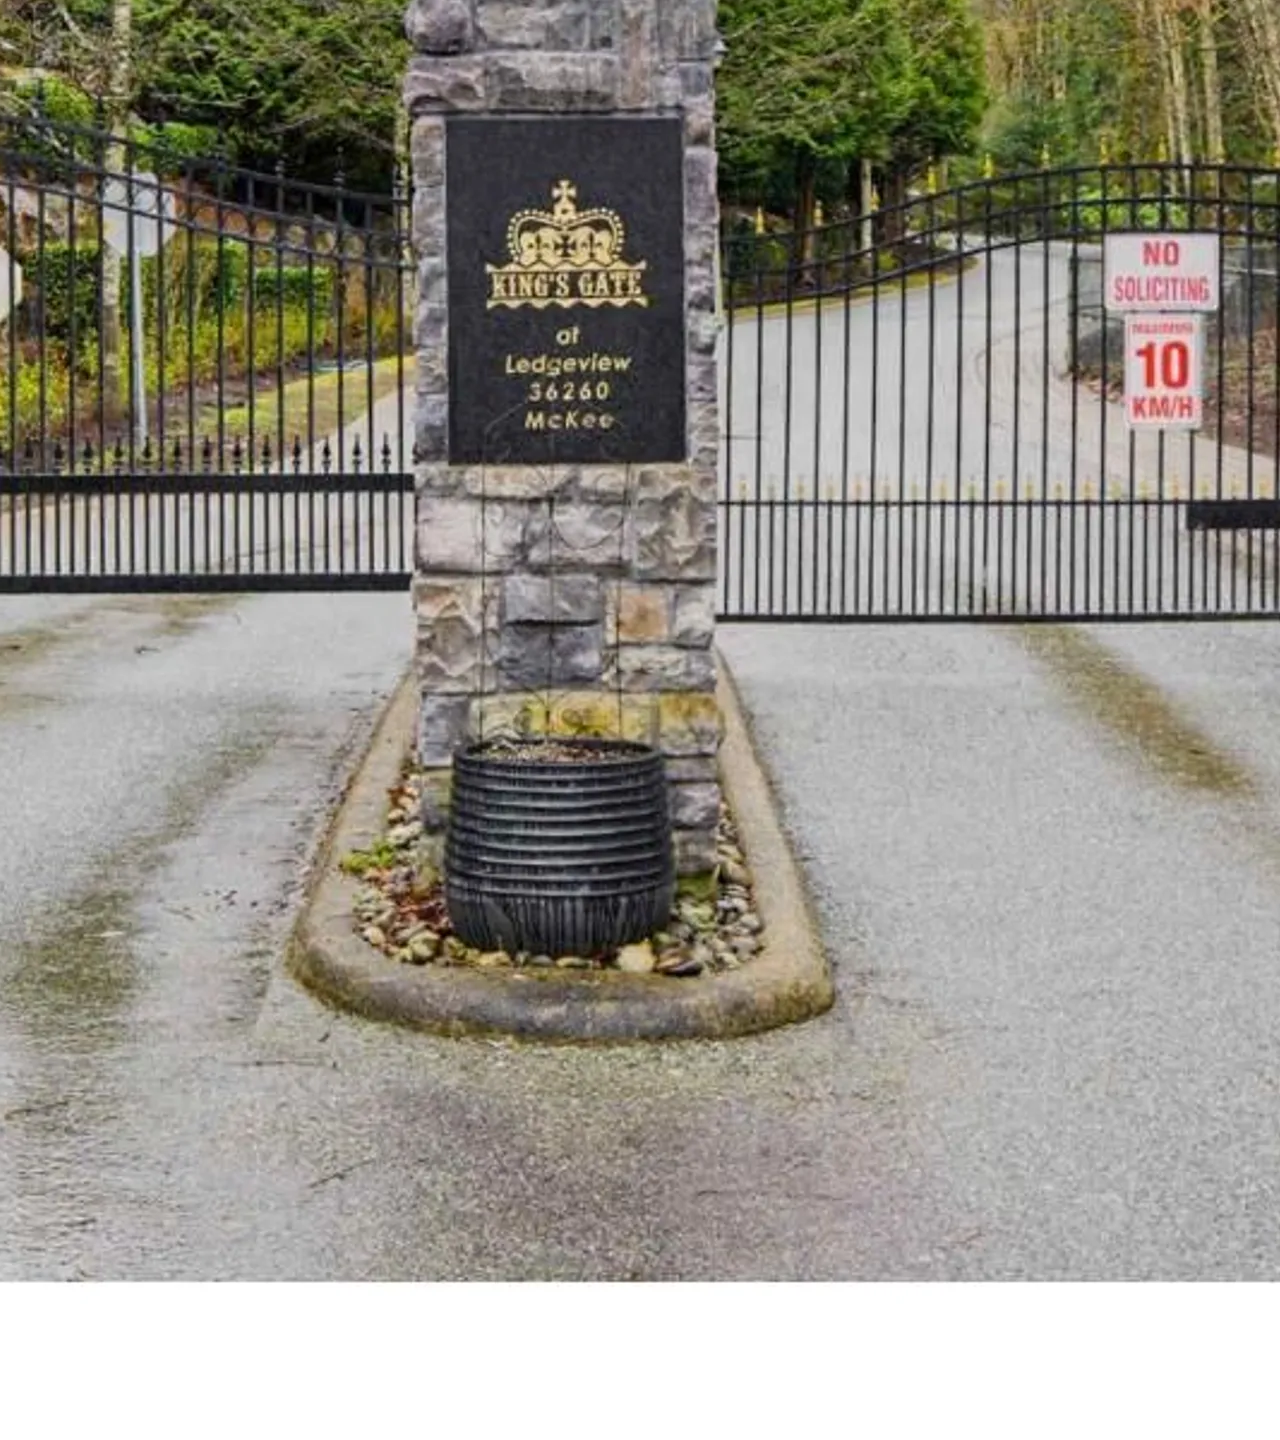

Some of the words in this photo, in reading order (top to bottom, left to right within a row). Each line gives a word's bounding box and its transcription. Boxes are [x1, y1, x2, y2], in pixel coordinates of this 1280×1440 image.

[1143, 240, 1179, 266] NO
[492, 272, 568, 297] KING'S
[579, 272, 641, 296] GATE
[1114, 276, 1210, 302] SOLICITING
[556, 326, 581, 345] at
[506, 353, 631, 375] Ledgeview
[1136, 341, 1189, 389] 10
[528, 381, 611, 401] 36260
[1132, 397, 1193, 419] KM/H
[525, 411, 615, 430] McKee
